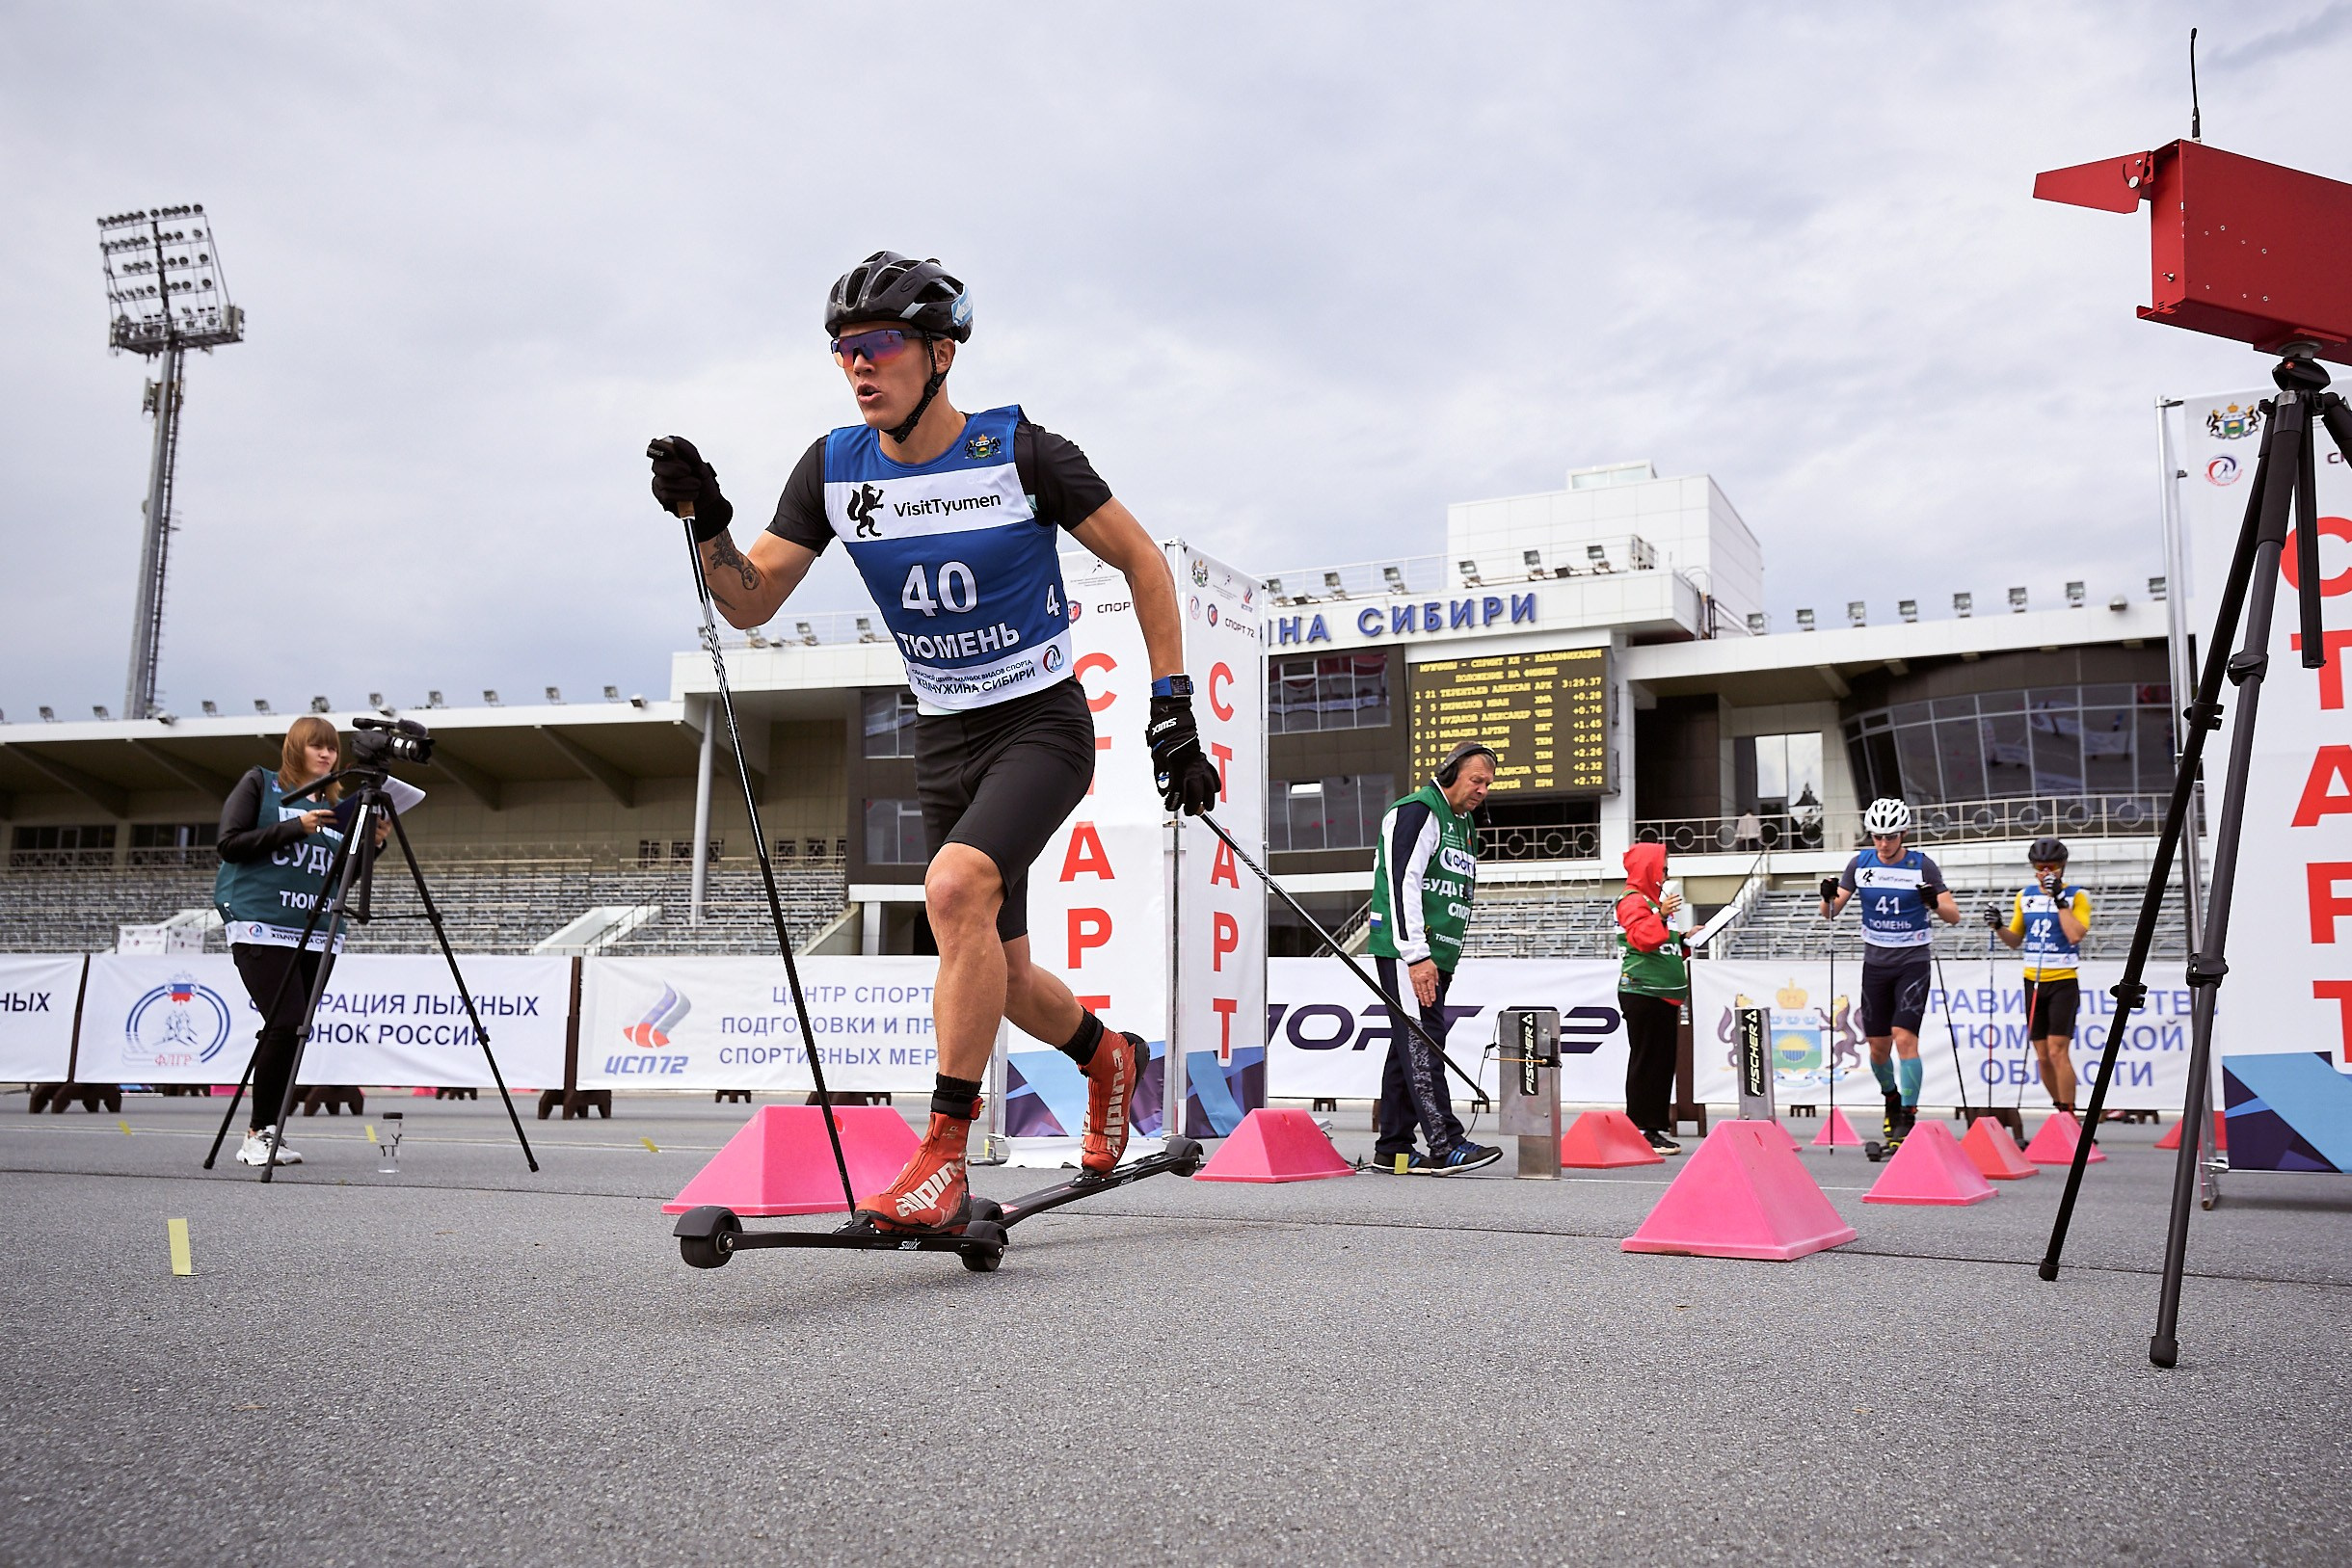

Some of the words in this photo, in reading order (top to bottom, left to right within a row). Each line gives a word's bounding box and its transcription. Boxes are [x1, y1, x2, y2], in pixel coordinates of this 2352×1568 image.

[894, 492, 1002, 518] VisitTyumen
[901, 560, 977, 617] 40
[1358, 593, 1536, 637] СИБИРИ
[1225, 618, 1246, 634] СПОРТ
[1246, 625, 1254, 637] 72
[896, 623, 1020, 659] ТЮМЕНЬ
[981, 668, 1005, 680] ВИДОВ
[1005, 659, 1032, 673] СПОРТА
[982, 667, 1035, 691] СИБИРИ
[1425, 689, 1435, 699] 21
[1573, 704, 1602, 715] +0.76
[1425, 730, 1436, 739] 15
[1573, 718, 1602, 730] +1.45
[1573, 732, 1602, 743] +2.04
[1573, 747, 1602, 757] +2.26
[1573, 761, 1602, 772] +2.32
[1573, 775, 1602, 785] +2.72
[1208, 661, 1240, 1059] СТАРТ
[1875, 895, 1900, 915] 41
[1869, 919, 1912, 929] ТЮМЕНЬ
[2030, 918, 2051, 938] 42
[884, 1018, 897, 1033] И
[155, 1054, 193, 1066] ФЛГР
[1525, 1026, 1535, 1094] FISCHER
[1749, 1023, 1760, 1096] FISCHER
